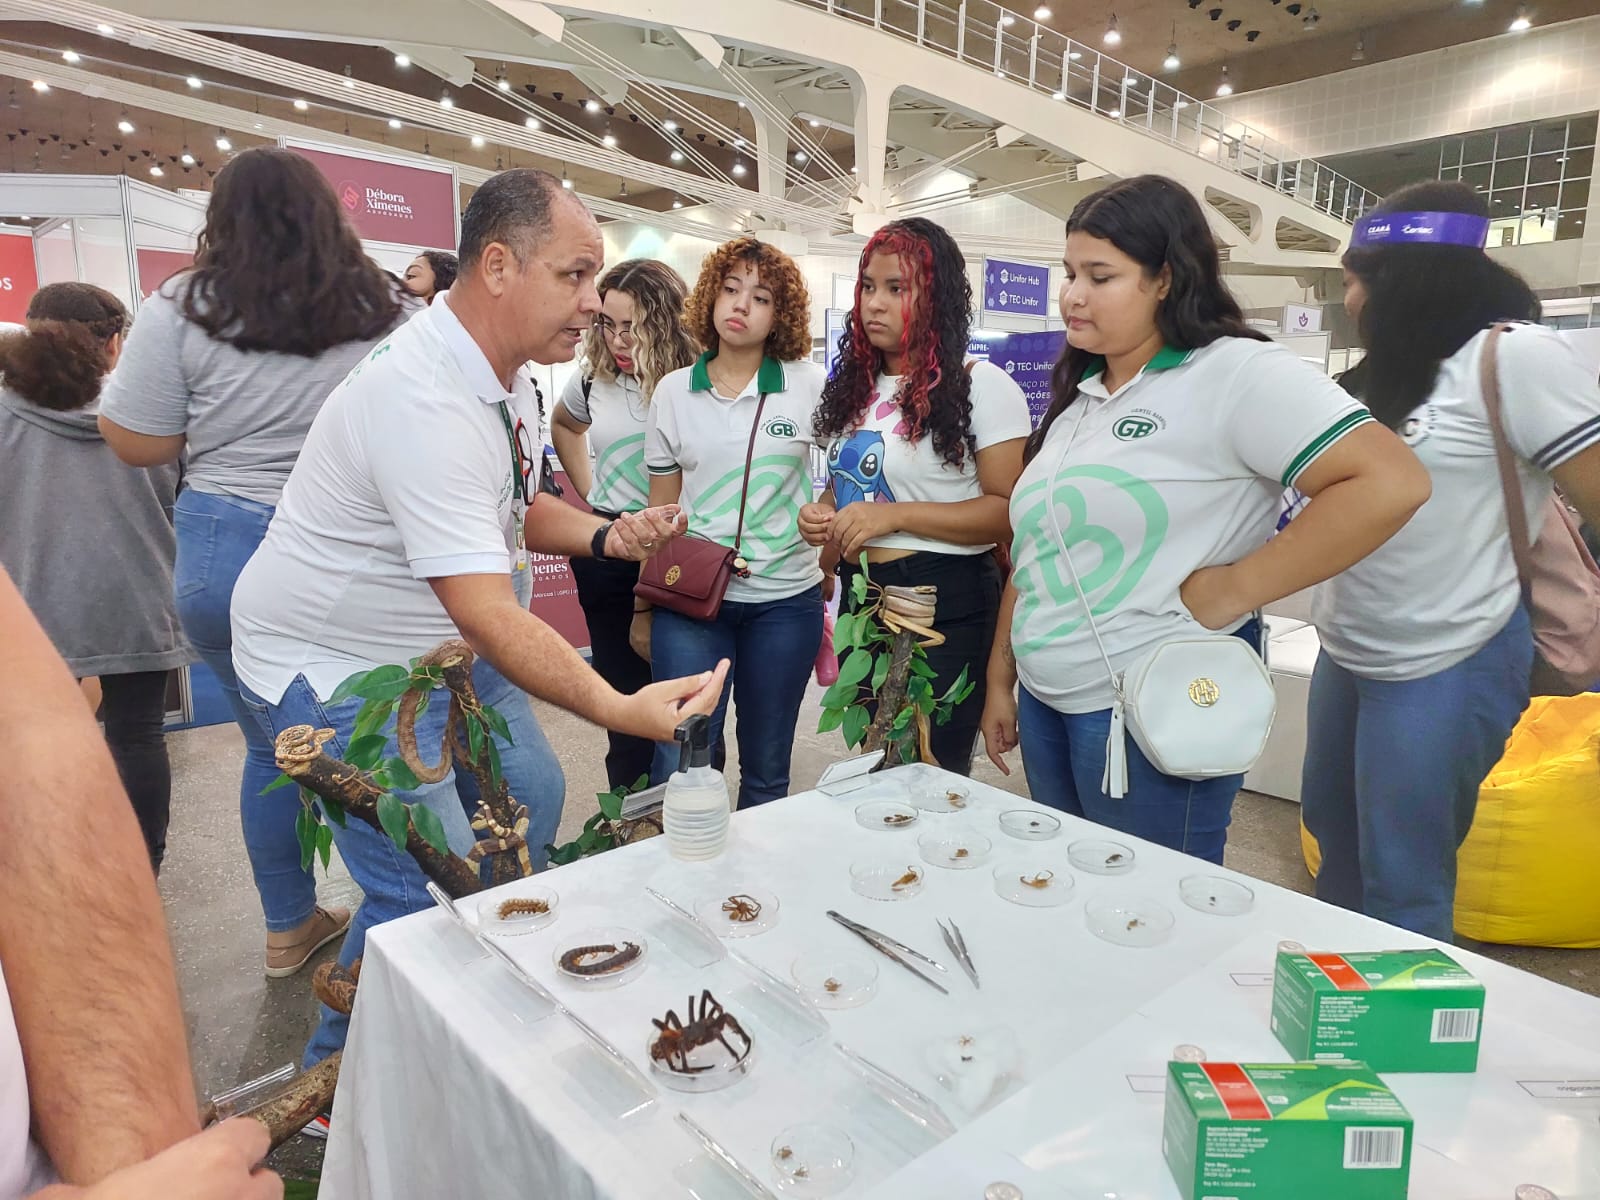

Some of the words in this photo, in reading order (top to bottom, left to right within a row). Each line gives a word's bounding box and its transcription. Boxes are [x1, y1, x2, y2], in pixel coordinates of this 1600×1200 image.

[365, 187, 405, 203] Débora
[366, 198, 413, 214] Ximenes
[1009, 272, 1028, 284] Unifor
[1028, 275, 1040, 286] Hub
[1009, 294, 1021, 304] TEC
[1021, 295, 1039, 306] Unifor
[1017, 362, 1032, 371] TEC
[1025, 390, 1051, 400] AÇÕES
[770, 422, 794, 437] GB
[1118, 419, 1154, 439] GB
[533, 574, 569, 582] GADOS
